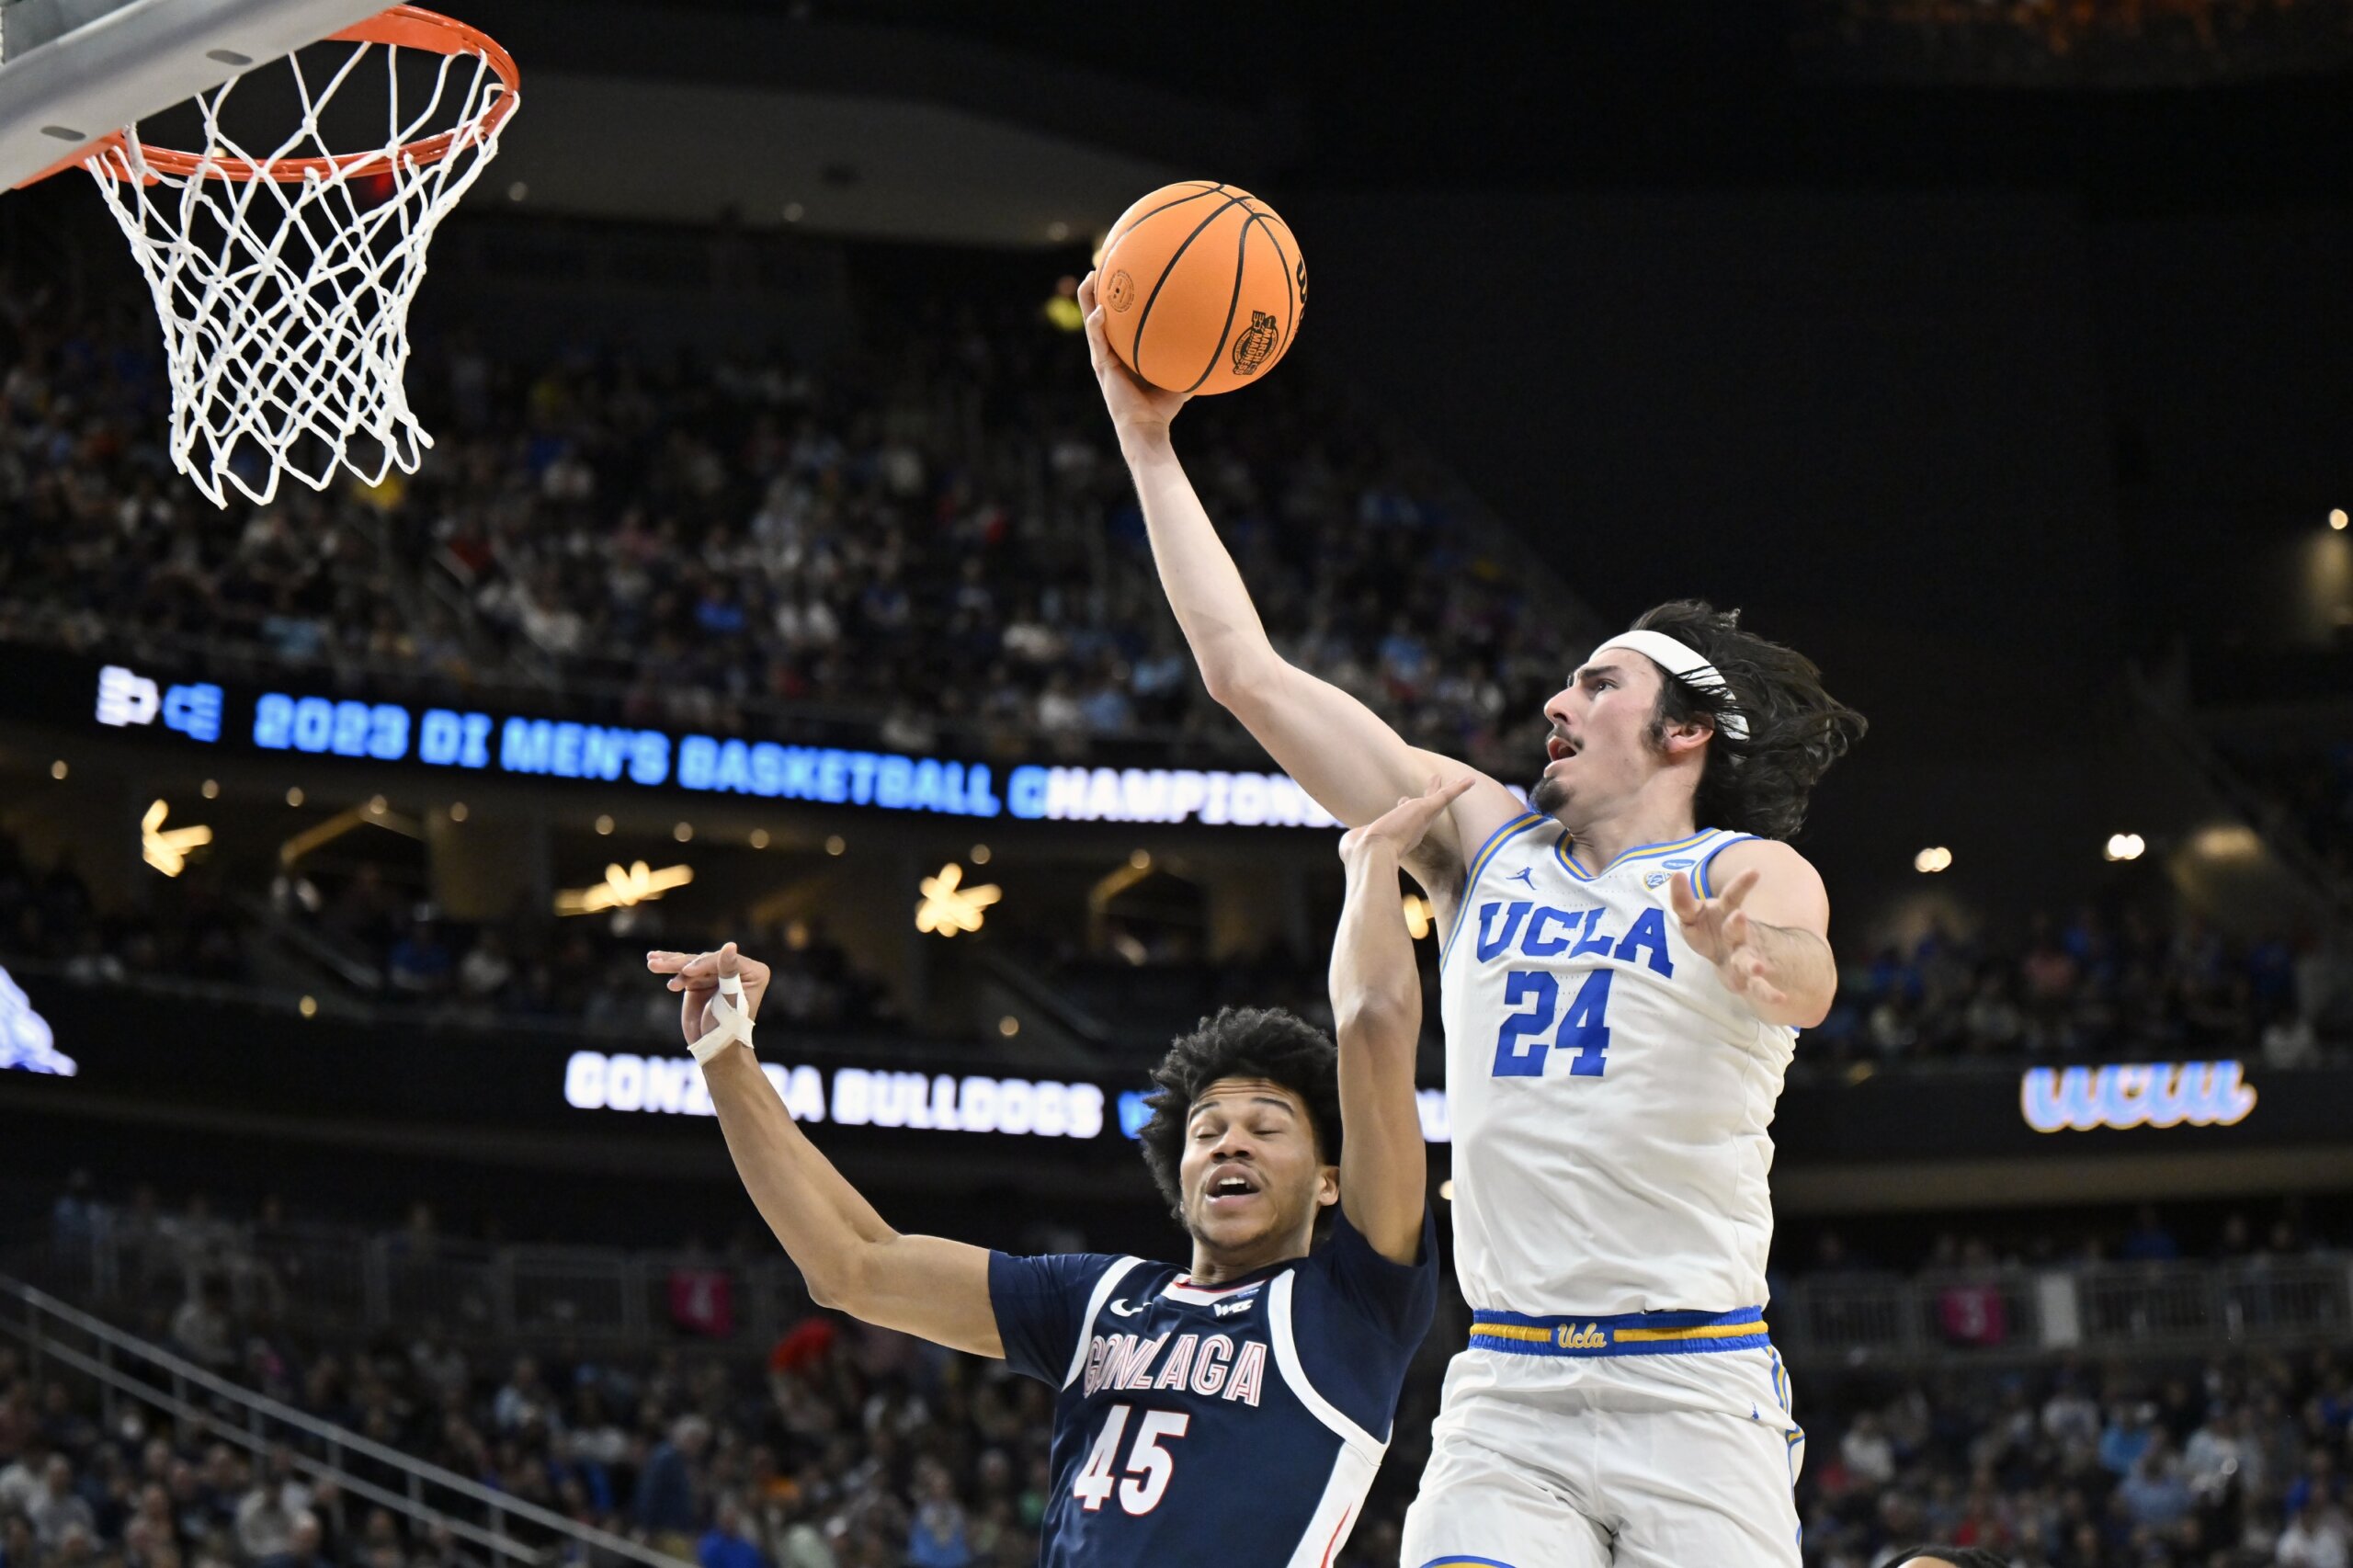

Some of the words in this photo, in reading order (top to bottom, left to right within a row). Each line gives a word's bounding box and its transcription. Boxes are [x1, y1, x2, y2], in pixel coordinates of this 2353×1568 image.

[1253, 327, 1275, 365] MARCH
[252, 692, 411, 761] 2023
[419, 708, 493, 769] DI
[500, 716, 672, 786] MEN'S
[677, 734, 1001, 817] BASKETBALL
[1477, 902, 1674, 979] UCLA
[1492, 969, 1614, 1076] 24
[564, 1050, 825, 1123] GONZA
[831, 1067, 1105, 1139] BULLDOGS
[1083, 1333, 1267, 1407] GONZAGA
[1074, 1404, 1190, 1517] 45
